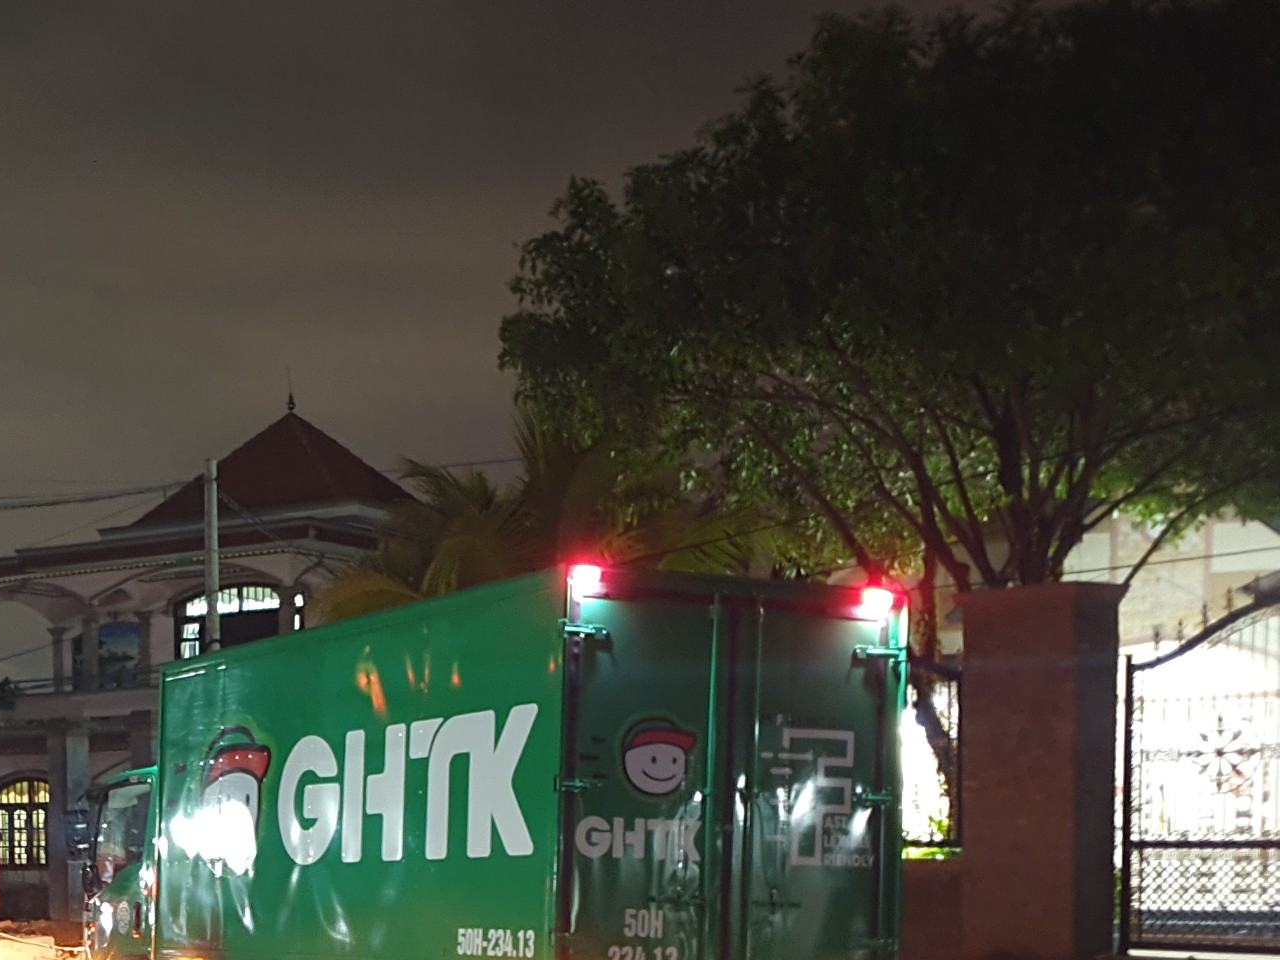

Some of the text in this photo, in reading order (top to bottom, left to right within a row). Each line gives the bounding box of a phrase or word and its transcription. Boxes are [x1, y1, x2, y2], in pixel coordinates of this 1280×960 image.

[278, 703, 539, 866] GHTK
[575, 815, 701, 862] GHTK
[624, 908, 663, 938] 50H
[457, 928, 536, 958] 50H-234.13
